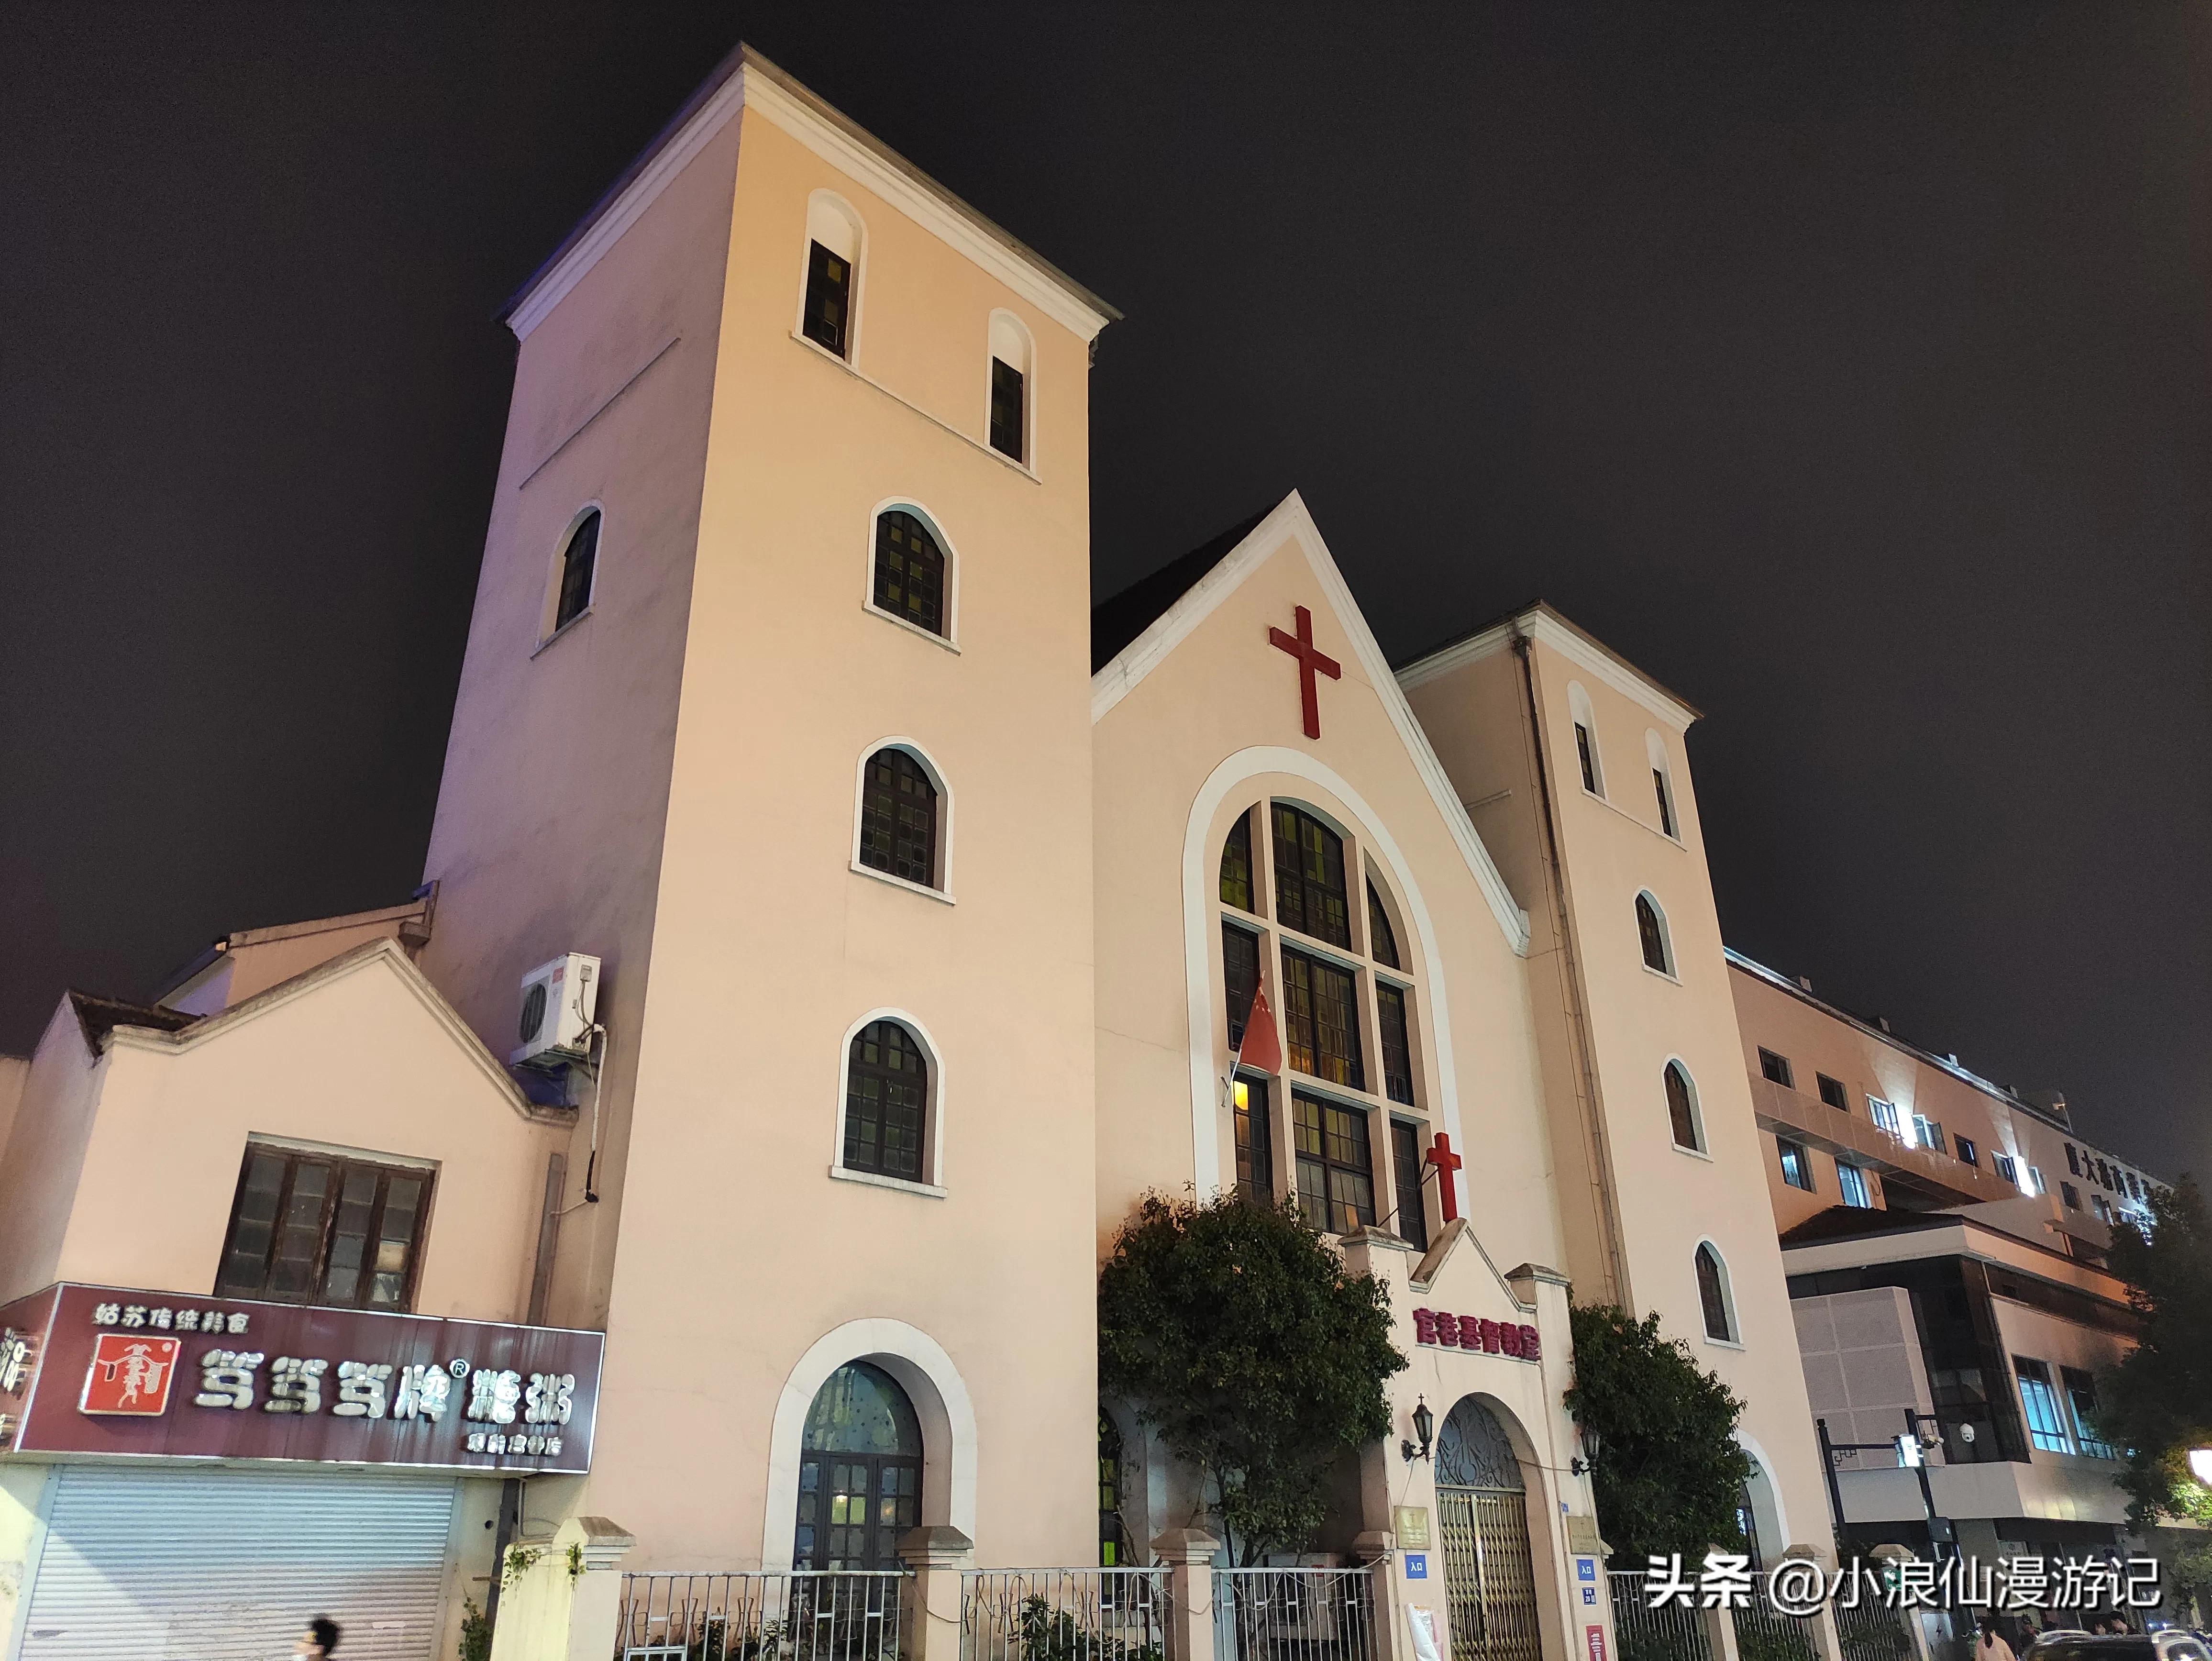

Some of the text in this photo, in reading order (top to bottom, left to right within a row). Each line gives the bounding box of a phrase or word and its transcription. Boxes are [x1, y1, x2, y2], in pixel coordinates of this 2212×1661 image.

[93, 1303, 250, 1334] 姑苏传统美食
[1410, 1561, 1423, 1572] 入口
[1582, 1565, 1592, 1574] 入口
